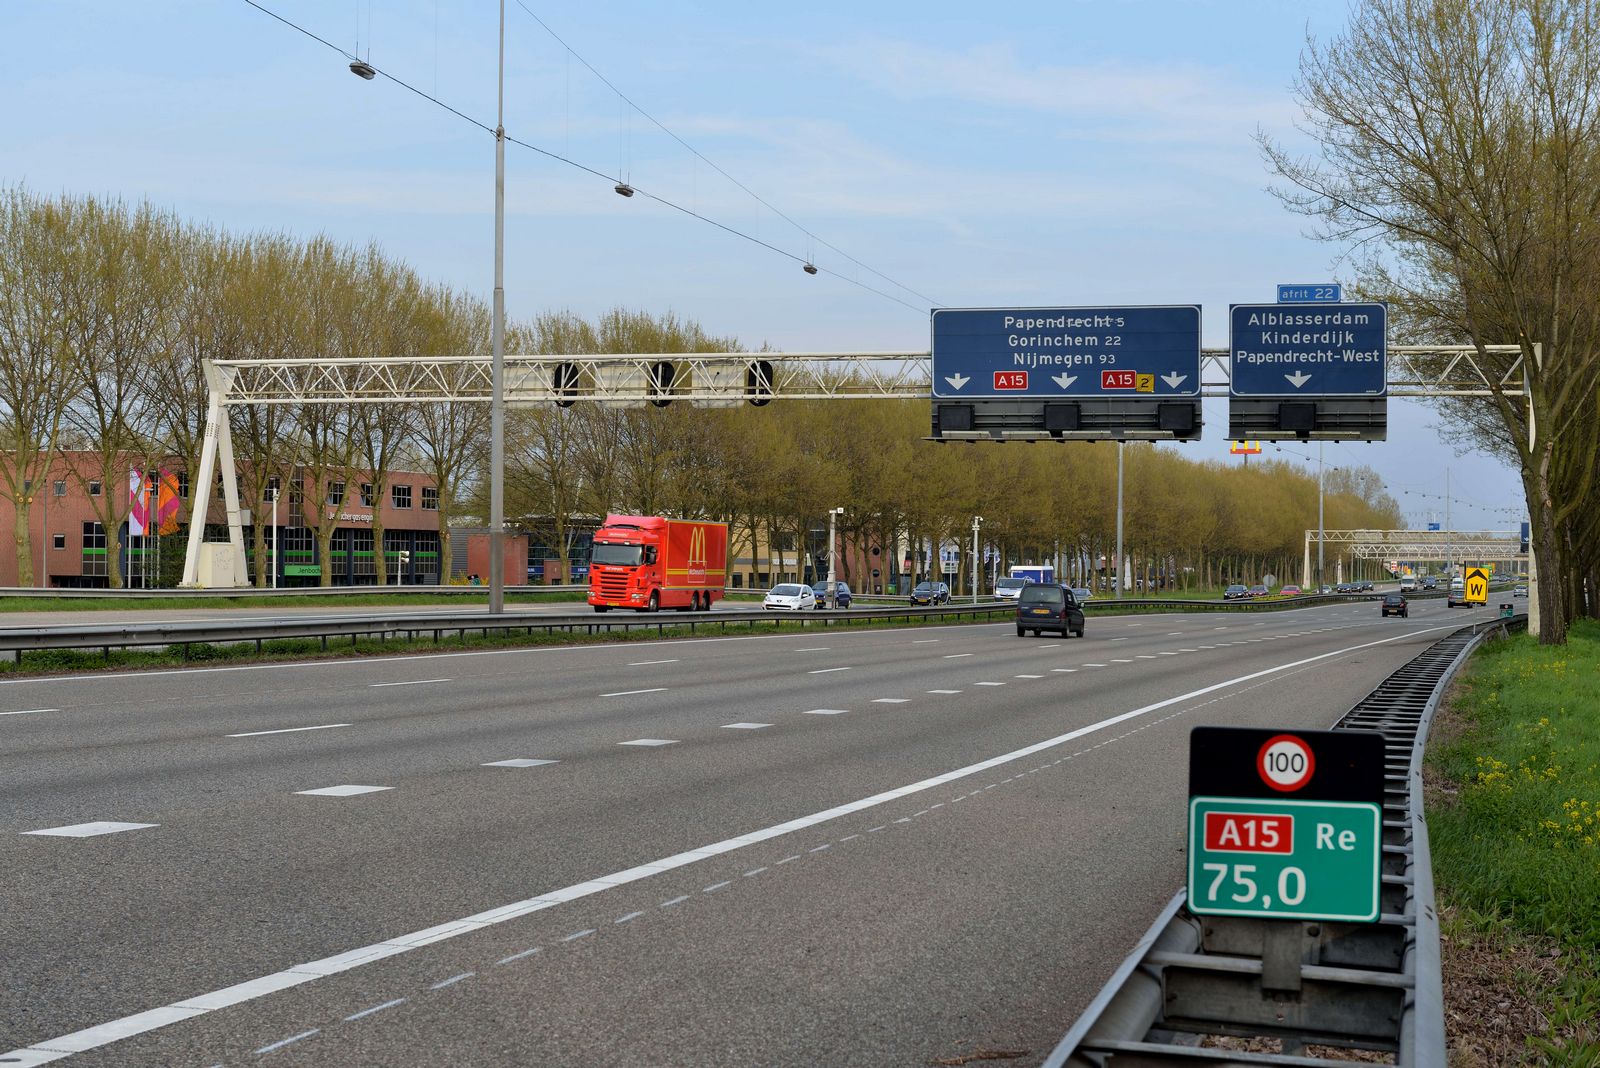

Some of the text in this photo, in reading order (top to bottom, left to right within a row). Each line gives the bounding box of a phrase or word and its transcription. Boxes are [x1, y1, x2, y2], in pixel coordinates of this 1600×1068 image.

[1282, 288, 1334, 299] afrit 22
[1004, 315, 1125, 331] Papendrecht 5
[1248, 312, 1369, 325] Alblasserdam
[1008, 334, 1121, 347] Gorinchem 22
[1261, 330, 1354, 347] Kinderdijk
[1014, 352, 1116, 368] Nijmegen 93
[1236, 350, 1380, 365] Papendrecht-West
[1141, 378, 1150, 388] 2
[1470, 584, 1483, 596] W
[1268, 752, 1305, 774] 100
[1218, 819, 1356, 851] A15 Re
[1202, 863, 1306, 910] 75,0
